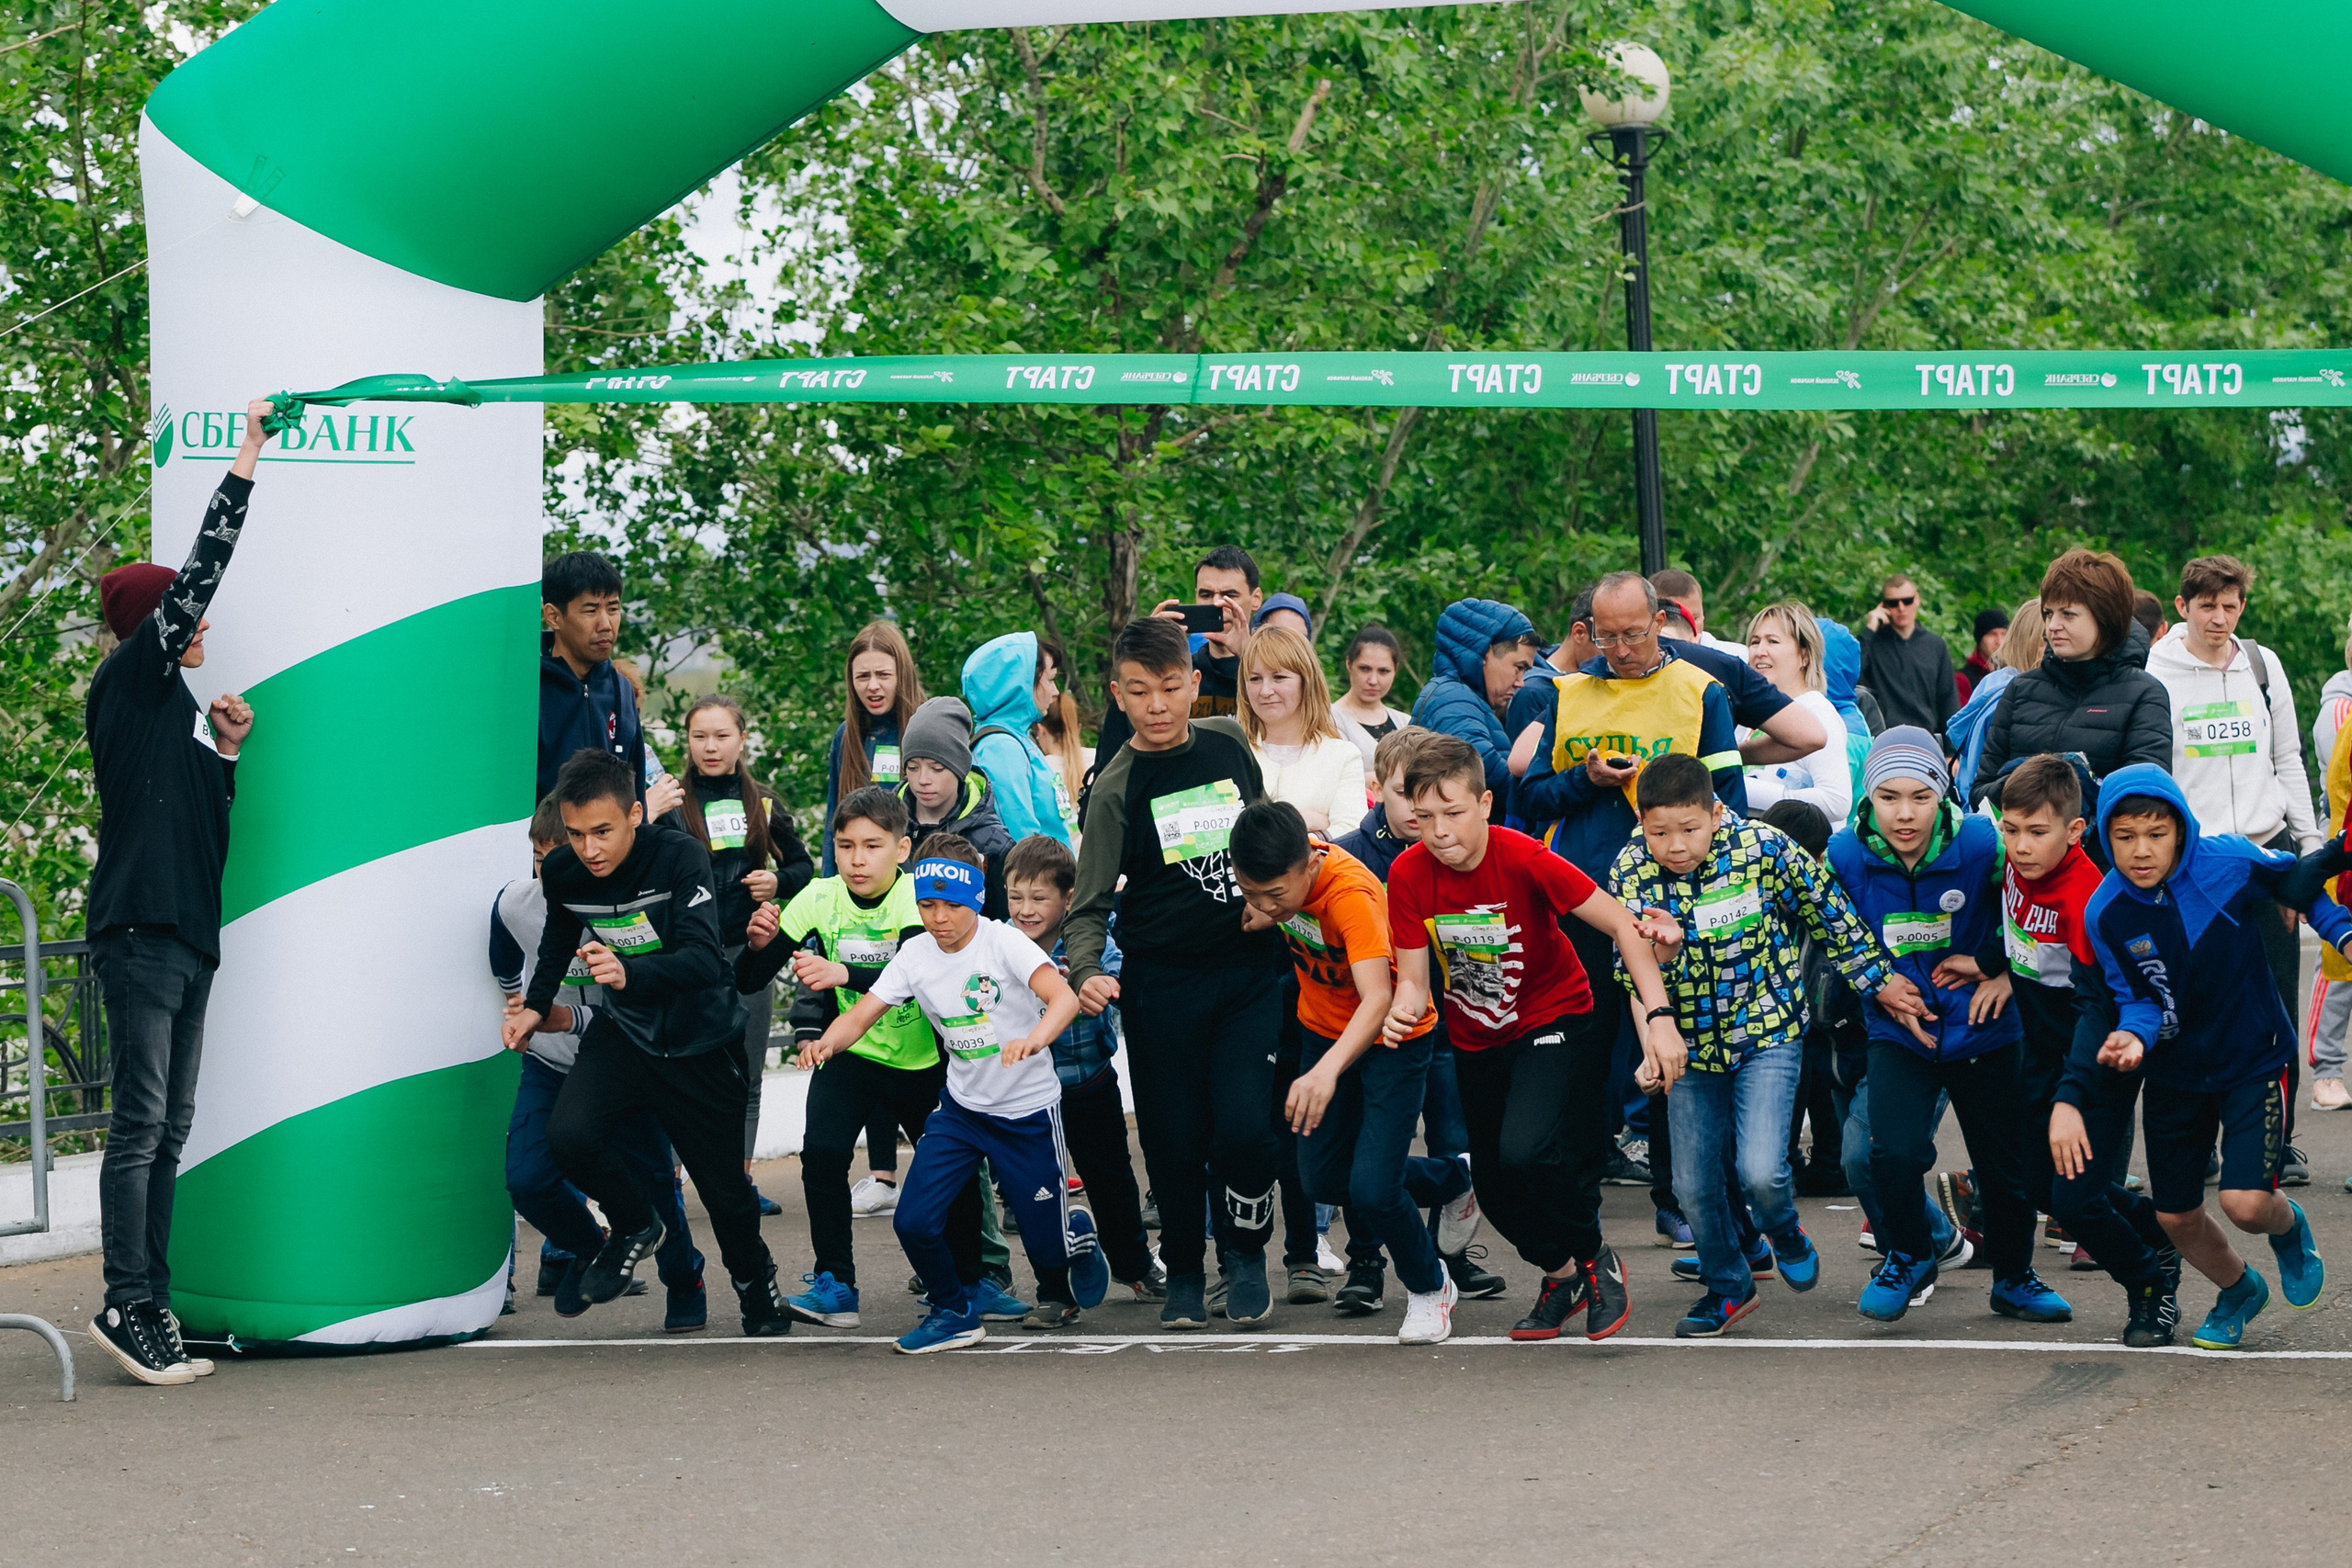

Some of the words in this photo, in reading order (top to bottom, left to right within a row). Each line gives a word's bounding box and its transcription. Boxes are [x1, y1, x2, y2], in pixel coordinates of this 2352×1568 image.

[182, 411, 415, 452] СБЕБАНК
[2207, 720, 2251, 739] 0258
[1193, 818, 1230, 830] P-0027
[915, 863, 971, 886] LUKOIL
[1710, 906, 1747, 927] P-0142
[1453, 935, 1495, 944] P-0119
[1896, 932, 1939, 943] P-0005
[850, 953, 890, 963] P-0022
[949, 1037, 985, 1049] P-0039
